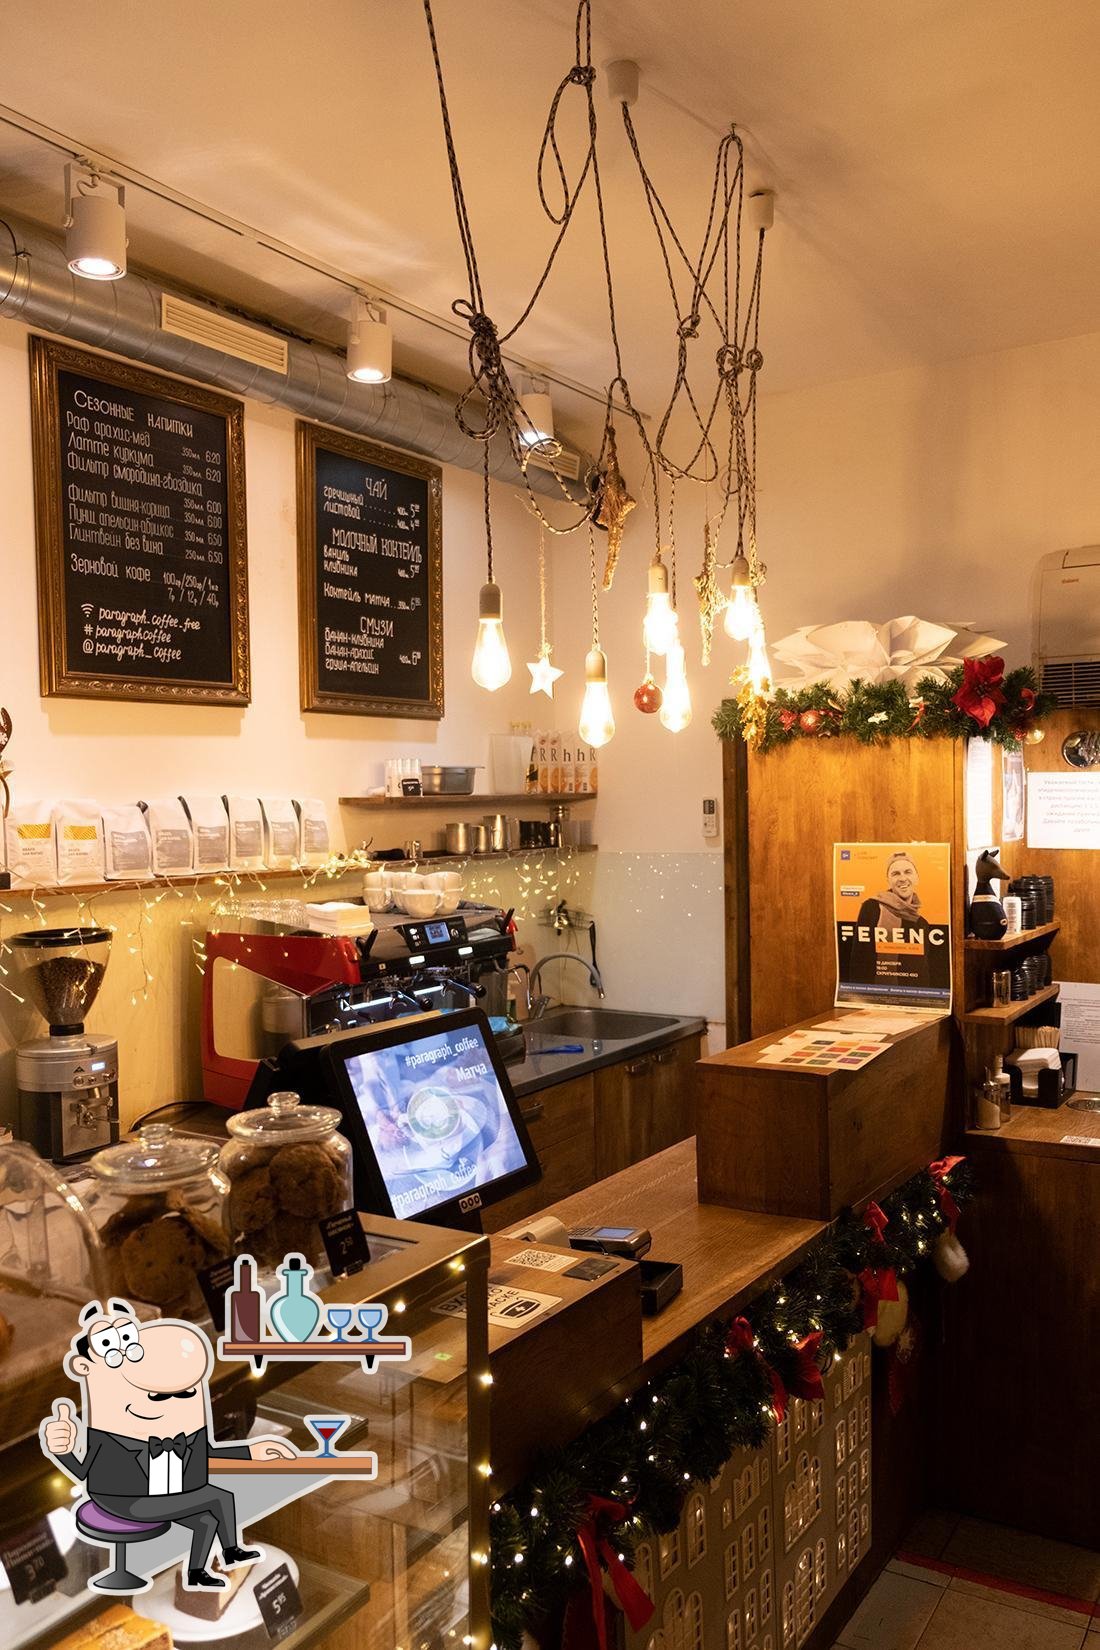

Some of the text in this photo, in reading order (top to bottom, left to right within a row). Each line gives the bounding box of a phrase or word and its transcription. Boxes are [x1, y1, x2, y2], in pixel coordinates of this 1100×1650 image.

[66, 411, 90, 433] Раф
[94, 421, 150, 448] арахис-мед
[147, 413, 193, 438] НАПИТКИ
[68, 432, 110, 456] Латте
[113, 446, 154, 467] куркума
[67, 451, 109, 479] Фильтр
[113, 465, 203, 496] смородина-гвоздика
[365, 477, 388, 500] ЧАЙ
[68, 483, 108, 508] Фильтр
[111, 490, 170, 518] вишня-корица
[69, 503, 96, 525] Пунш
[99, 512, 174, 538] апельсин-абрикос
[125, 532, 141, 551] без
[142, 534, 164, 555] вина
[332, 527, 422, 563] МОЛОЧНЫЙ КОКТЕЙЛЬ
[70, 553, 119, 578] Зерновой
[125, 565, 151, 582] кофе
[360, 616, 394, 637] СМУЗИ
[841, 925, 945, 946] FERENC
[404, 1036, 479, 1069] #paragraph_coffee
[455, 1062, 488, 1083] Матча
